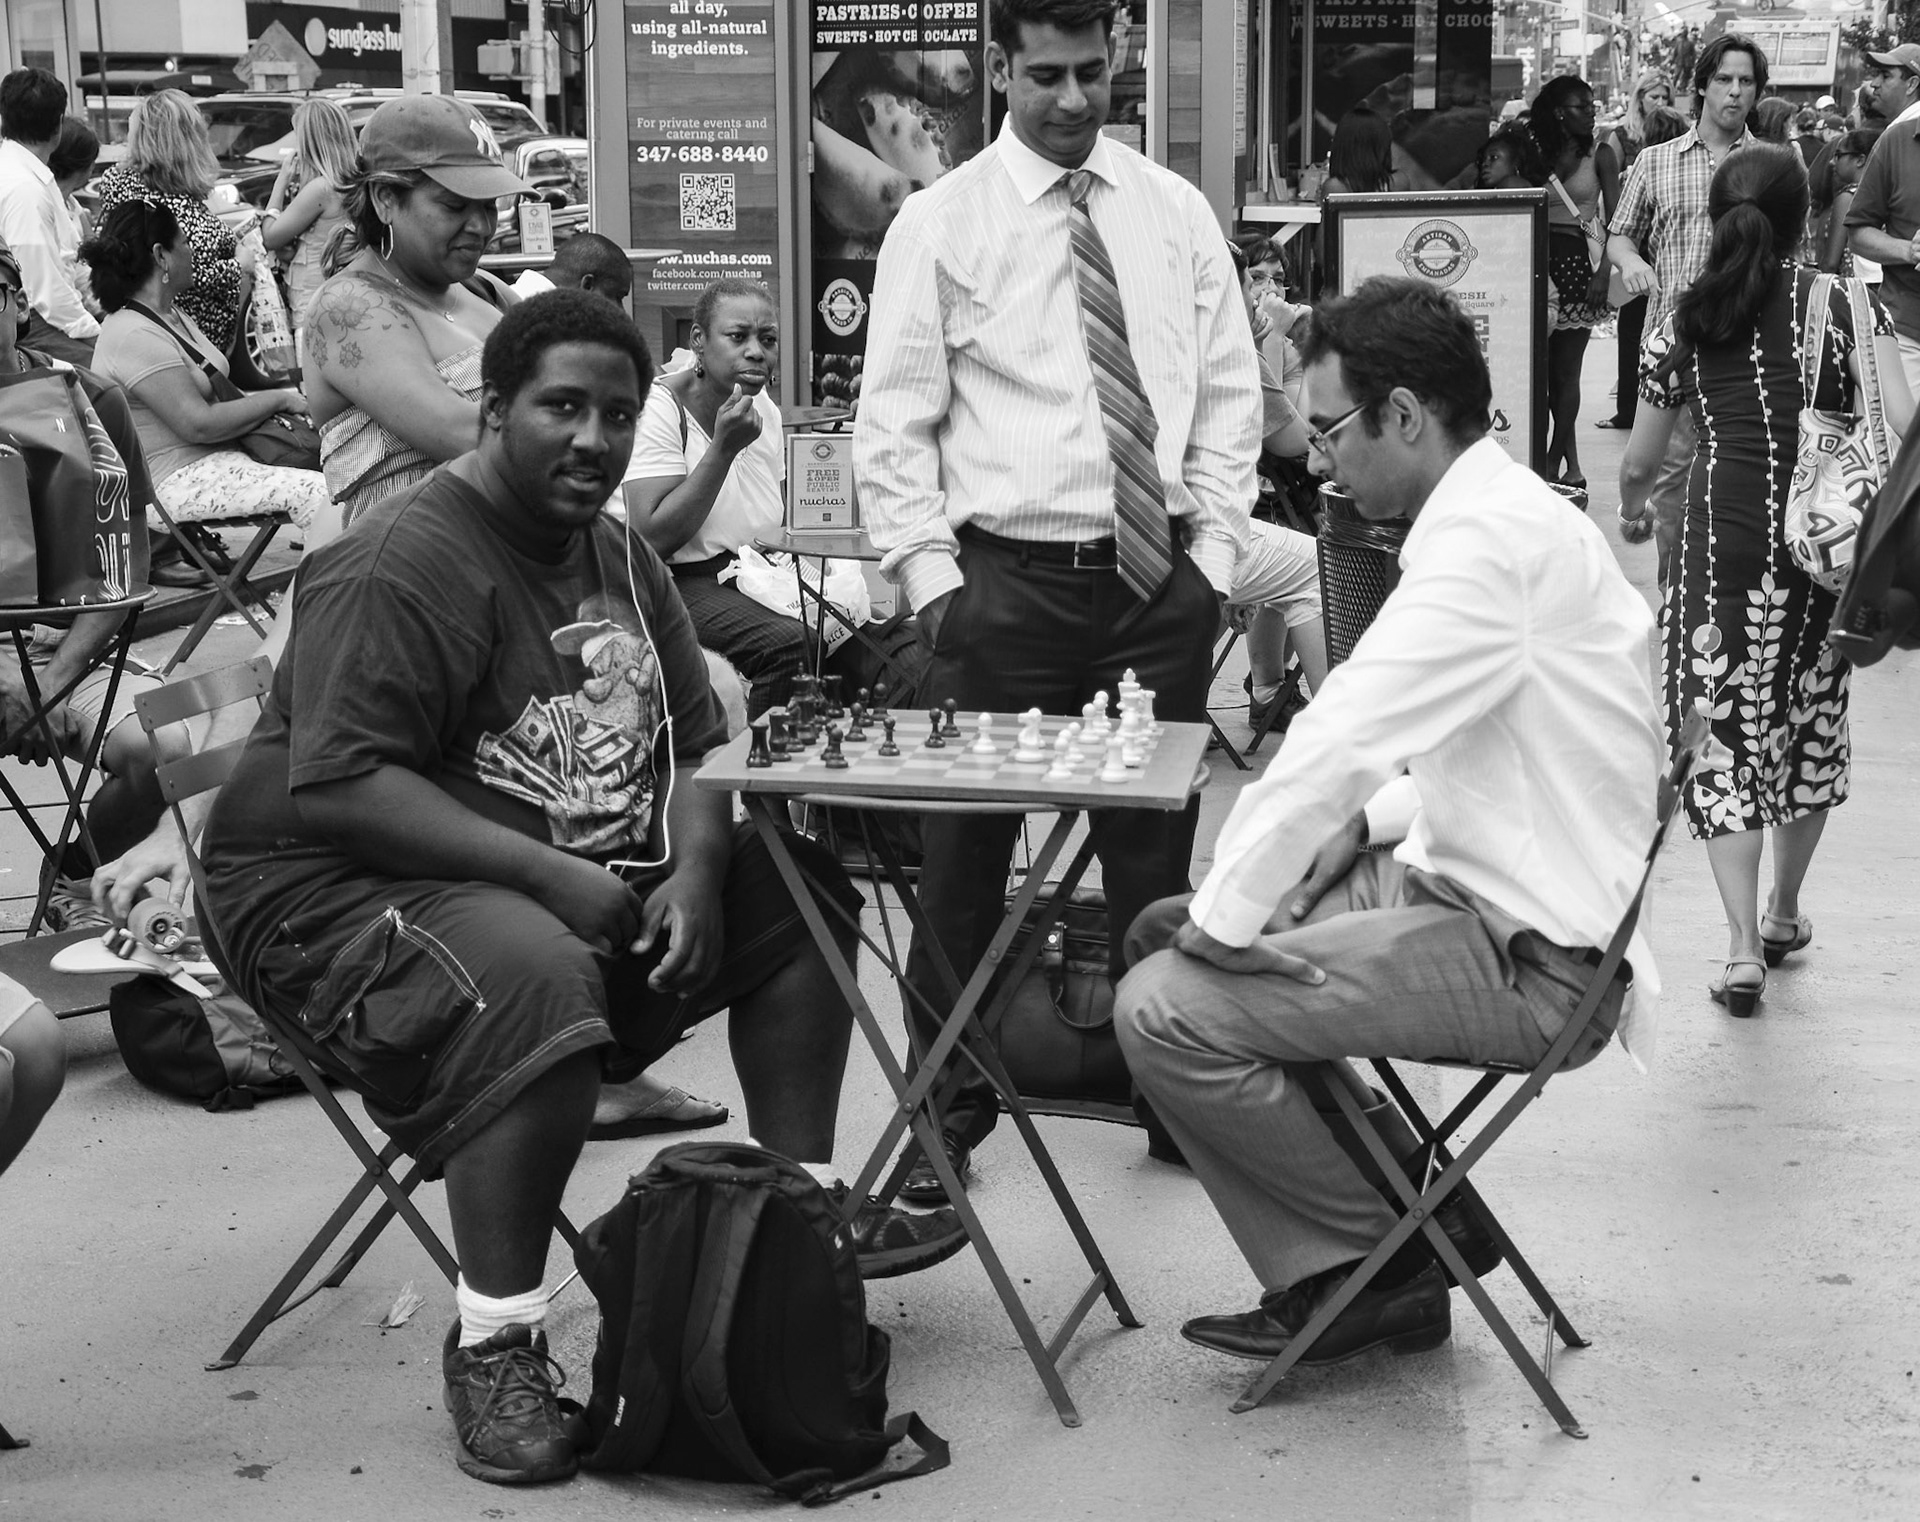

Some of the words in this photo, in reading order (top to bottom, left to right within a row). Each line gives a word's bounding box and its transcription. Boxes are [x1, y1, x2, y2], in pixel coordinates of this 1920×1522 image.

[670, 0, 689, 14] all
[695, 0, 728, 18] day,
[816, 4, 900, 21] PASTRIES
[907, 2, 978, 20] COFFEE
[631, 19, 677, 38] using
[681, 19, 768, 35] all-natural
[816, 31, 868, 44] SWEETS
[875, 30, 901, 43] HOT
[651, 40, 749, 59] ingredients.
[637, 117, 656, 128] For
[659, 117, 700, 131] private
[703, 118, 742, 128] events
[745, 117, 767, 128] and
[666, 129, 715, 142] catering
[717, 129, 739, 139] call
[1421, 232, 1453, 243] ARTISAN
[652, 268, 762, 279] facebook.com/nuchas
[1418, 262, 1455, 277] EMPANADAS
[1464, 301, 1495, 309] Square
[800, 496, 846, 505] nuchas
[786, 597, 810, 611] THAK
